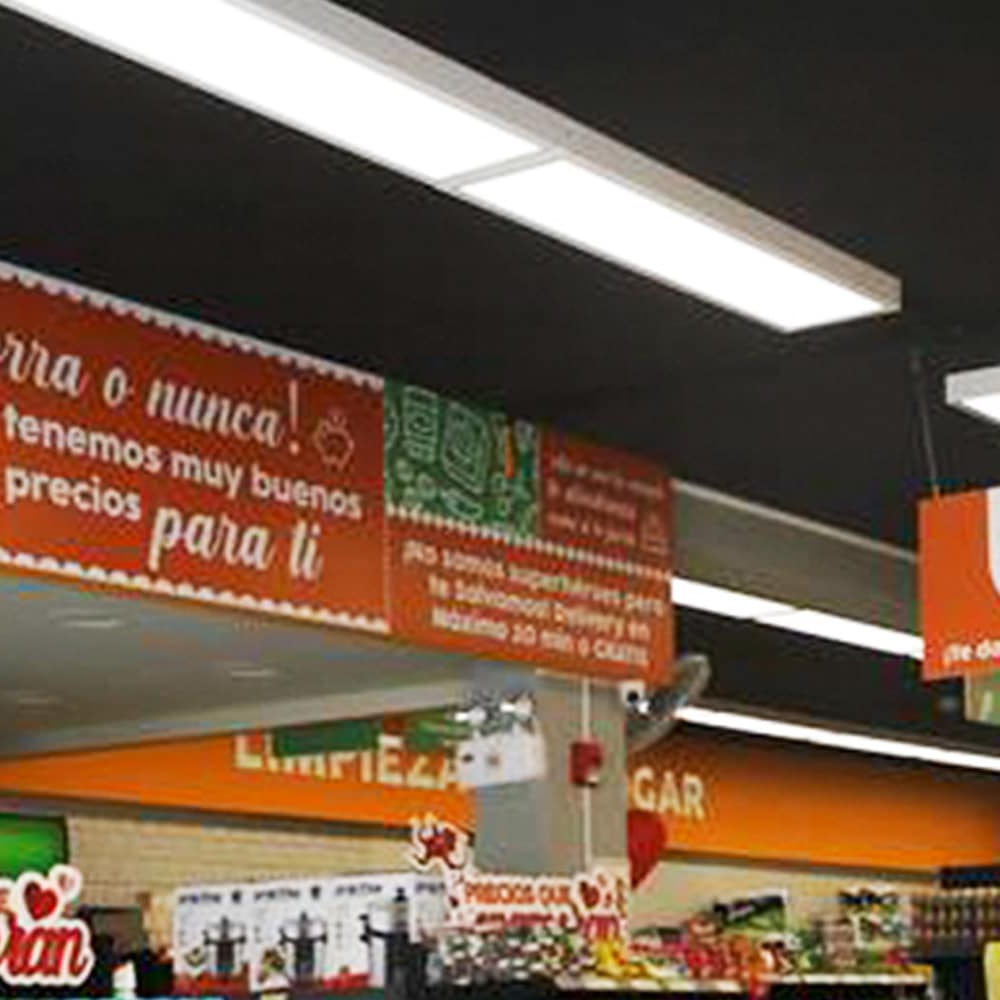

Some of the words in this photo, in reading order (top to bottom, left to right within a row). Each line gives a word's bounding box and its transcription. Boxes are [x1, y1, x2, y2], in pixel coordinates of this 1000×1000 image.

[104, 367, 133, 407] o
[146, 379, 302, 455] nunca!
[3, 404, 162, 474] tenemos
[171, 452, 243, 492] muy
[251, 466, 361, 520] buenos
[5, 466, 141, 521] precios
[148, 501, 274, 571] para
[285, 521, 323, 581] ti
[633, 765, 706, 820] GAR
